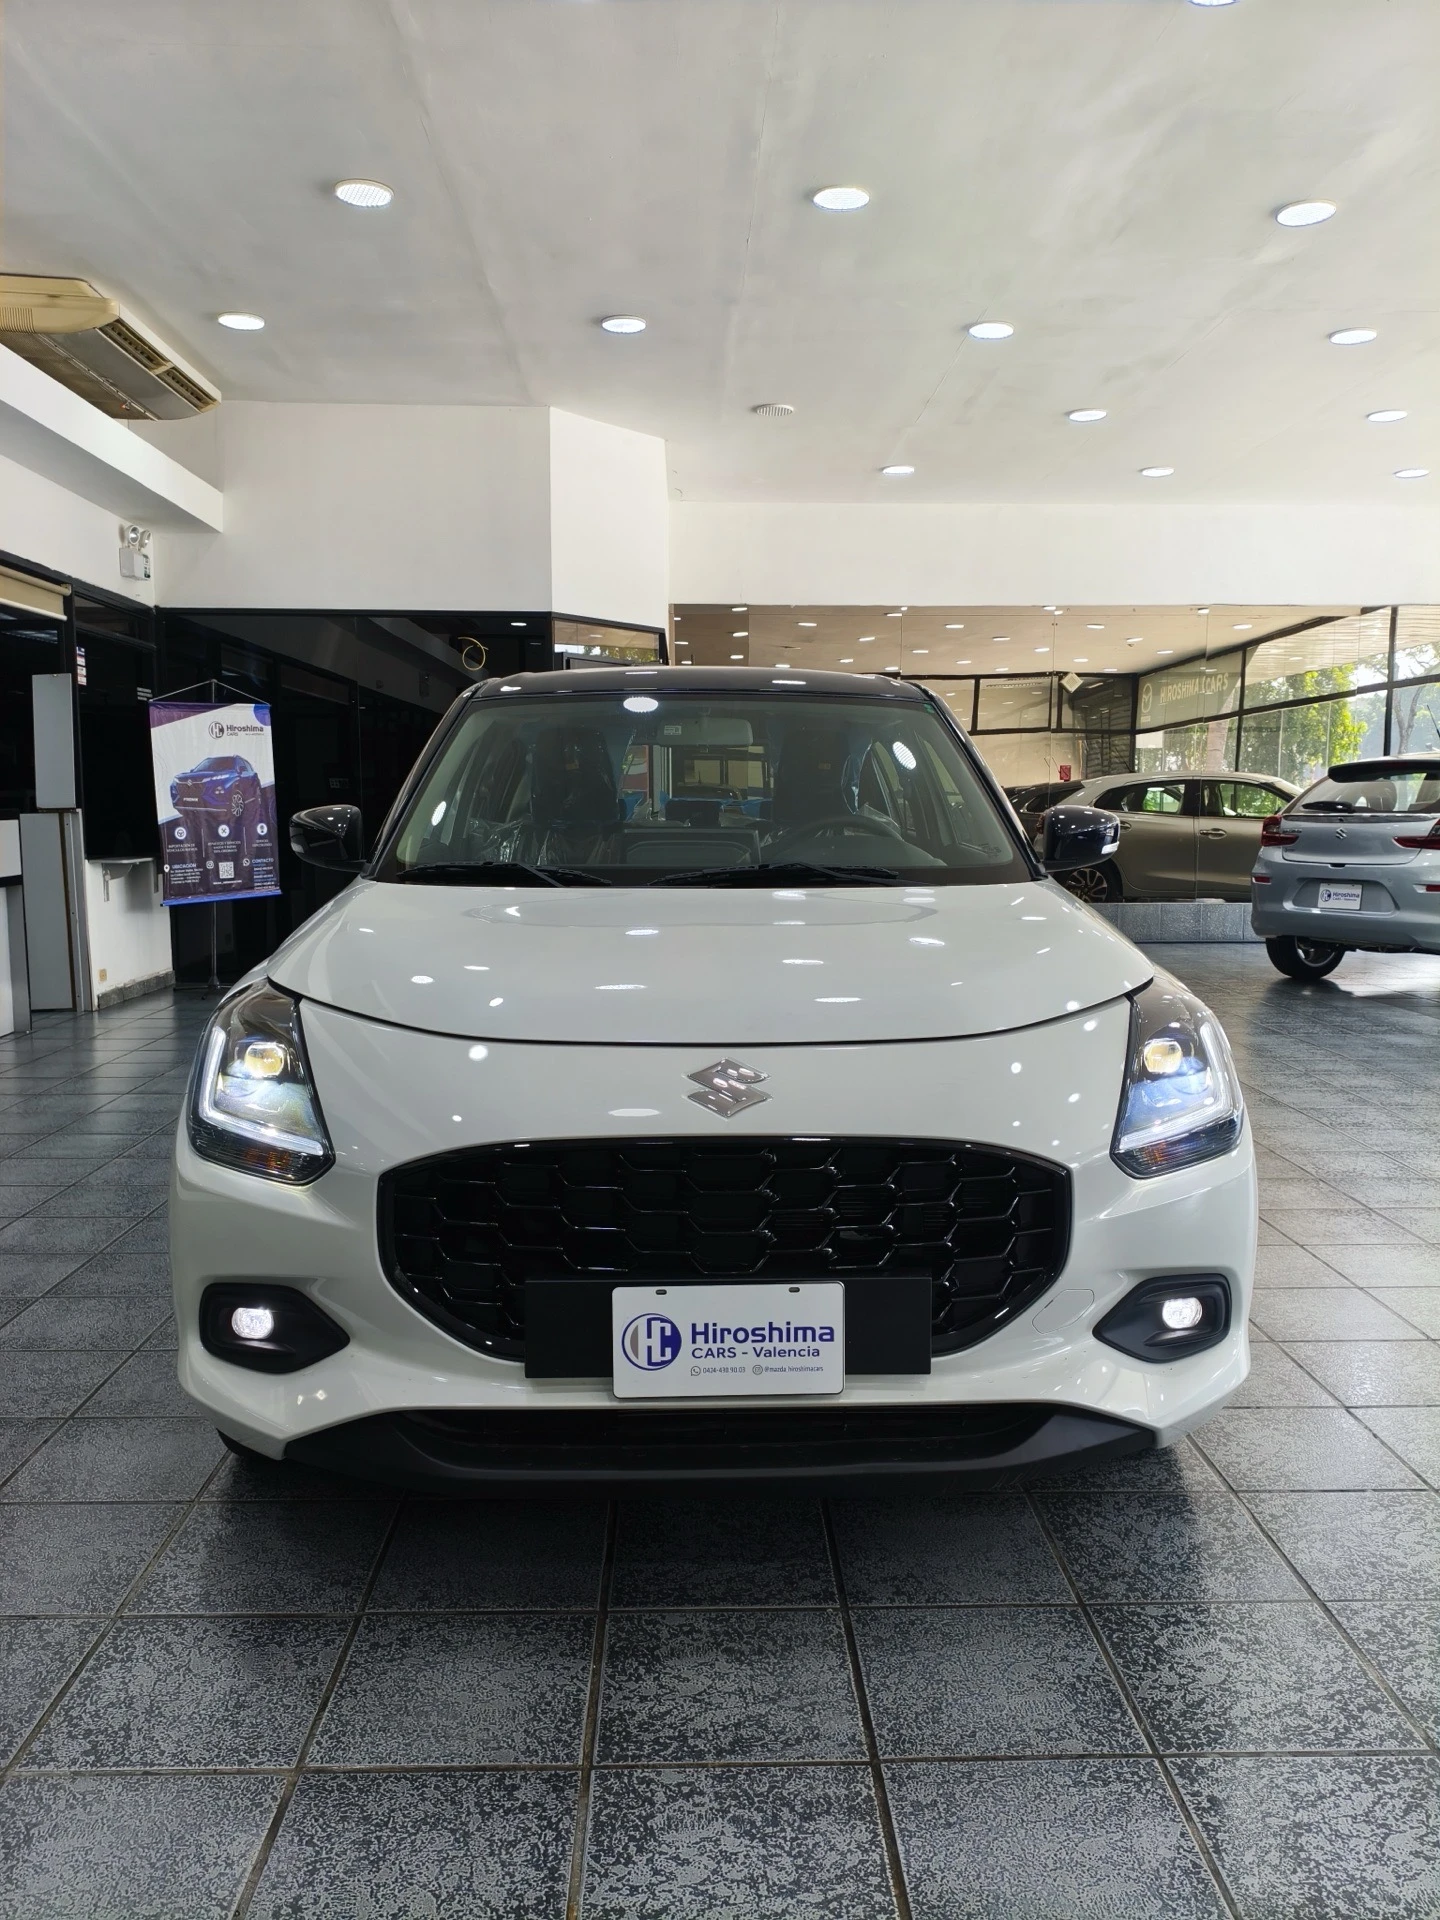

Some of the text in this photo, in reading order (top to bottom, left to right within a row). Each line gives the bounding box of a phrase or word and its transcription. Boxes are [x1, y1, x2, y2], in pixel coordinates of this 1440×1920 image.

[226, 724, 264, 732] Hiroshima
[691, 1321, 835, 1344] Hiroshima
[691, 1346, 737, 1359] CARS
[752, 1345, 820, 1358] Valencia
